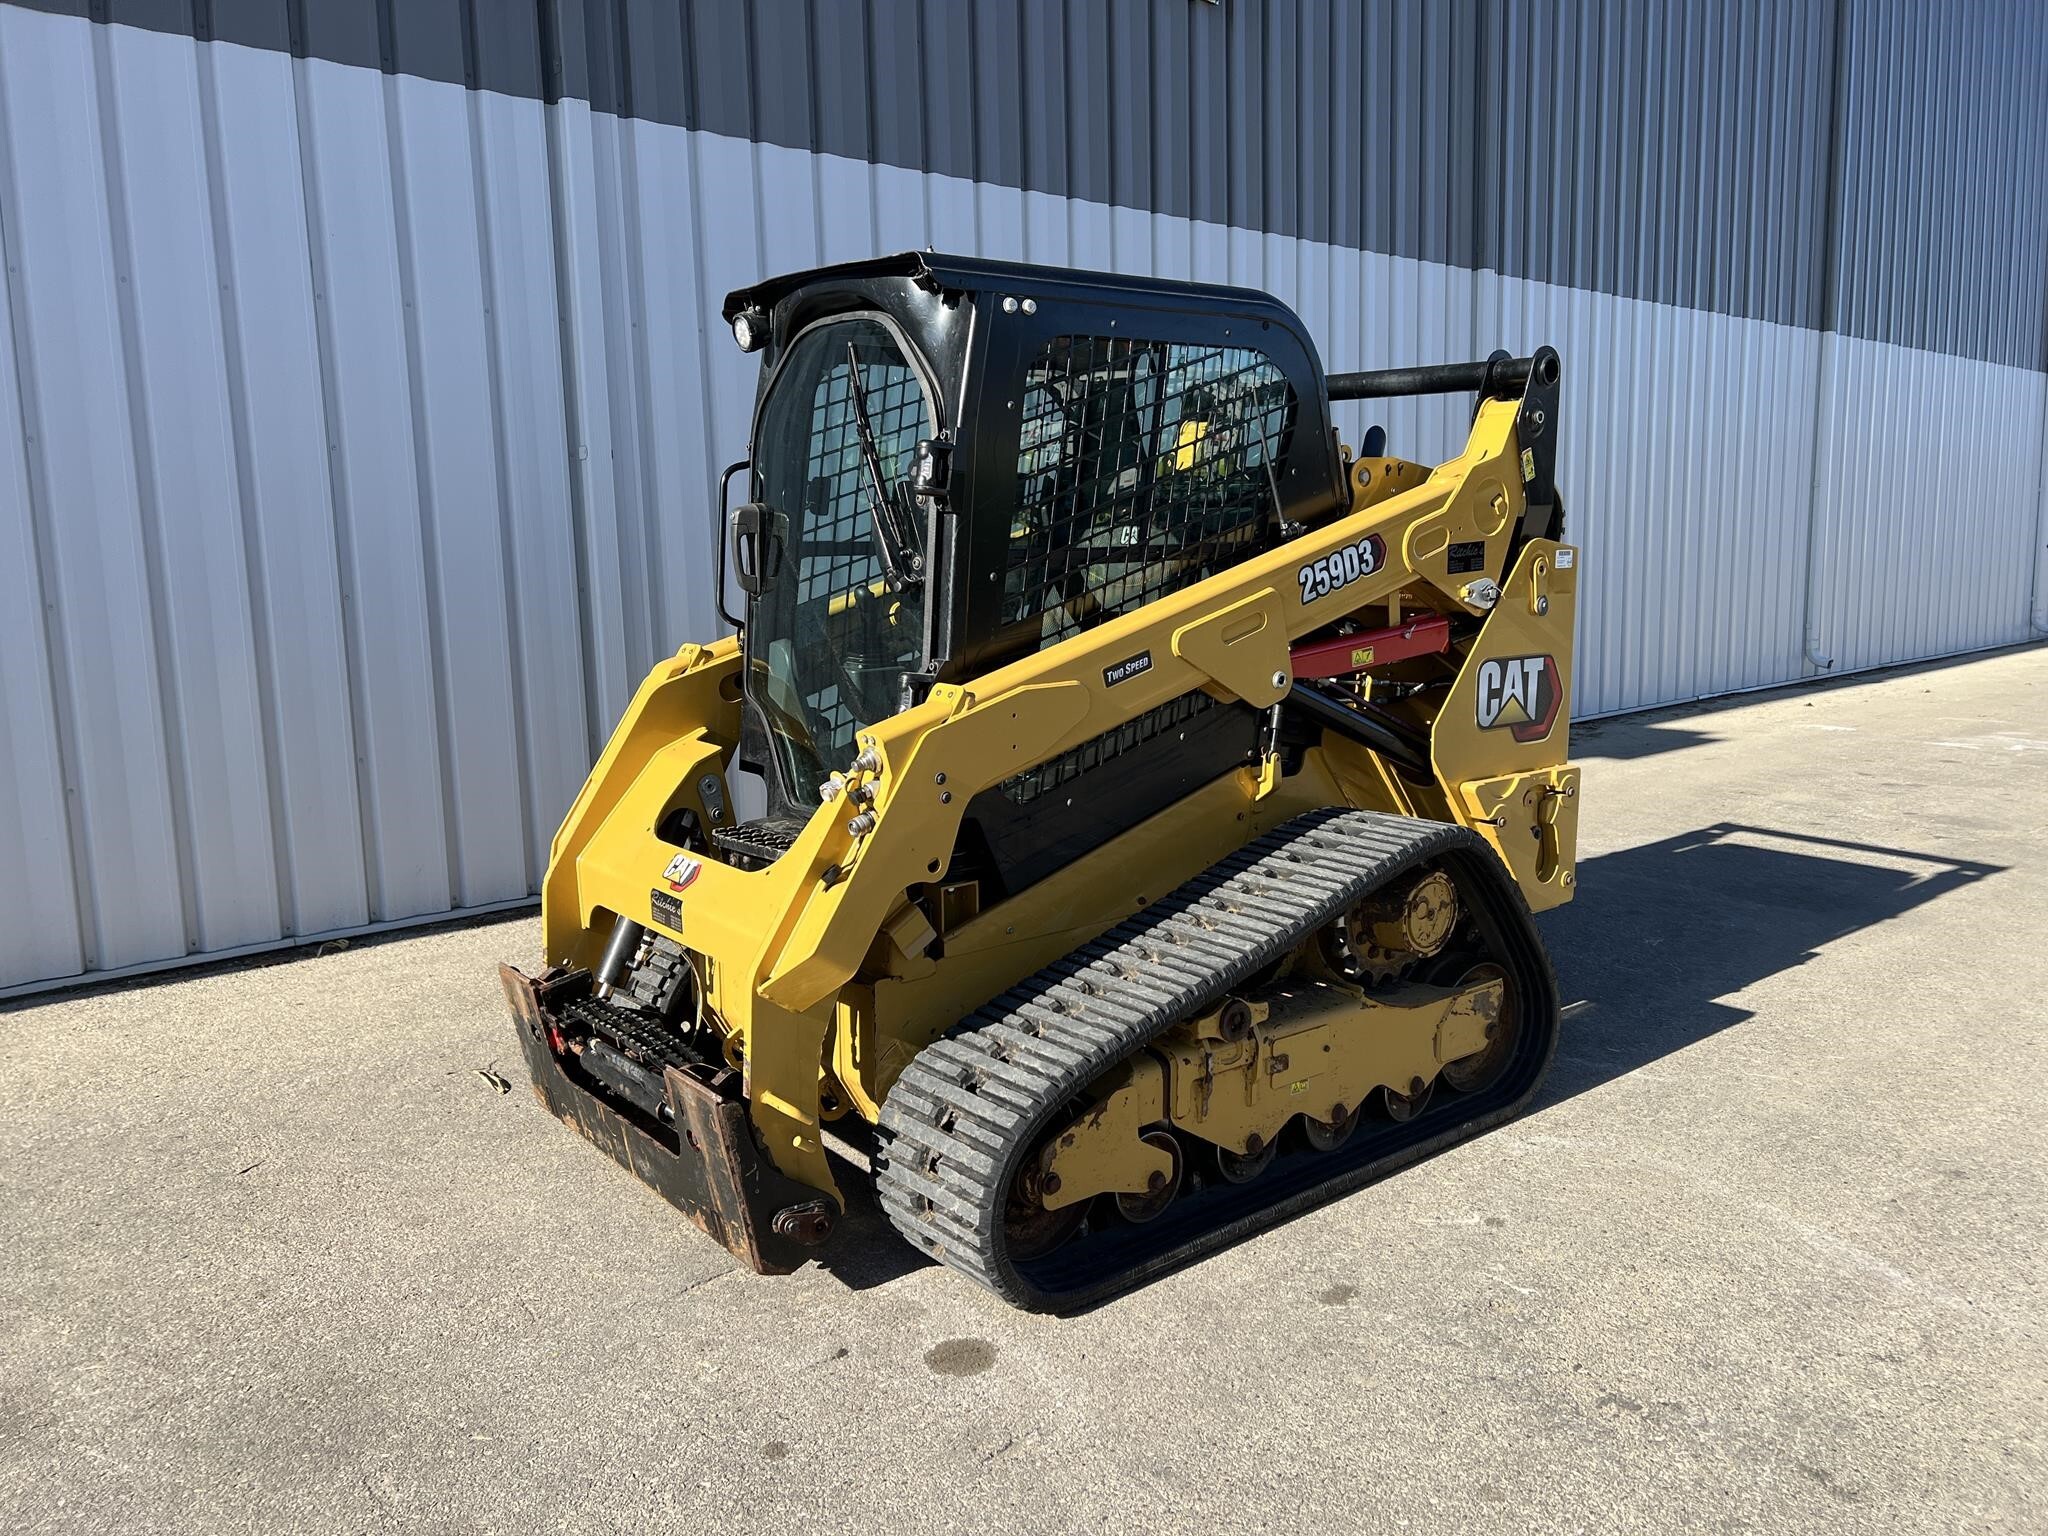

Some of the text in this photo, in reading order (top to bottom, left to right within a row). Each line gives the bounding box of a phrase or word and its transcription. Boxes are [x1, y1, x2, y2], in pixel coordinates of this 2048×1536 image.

[1299, 540, 1374, 603] 259D3
[1478, 657, 1544, 727] CAT
[663, 853, 699, 884] CAT
